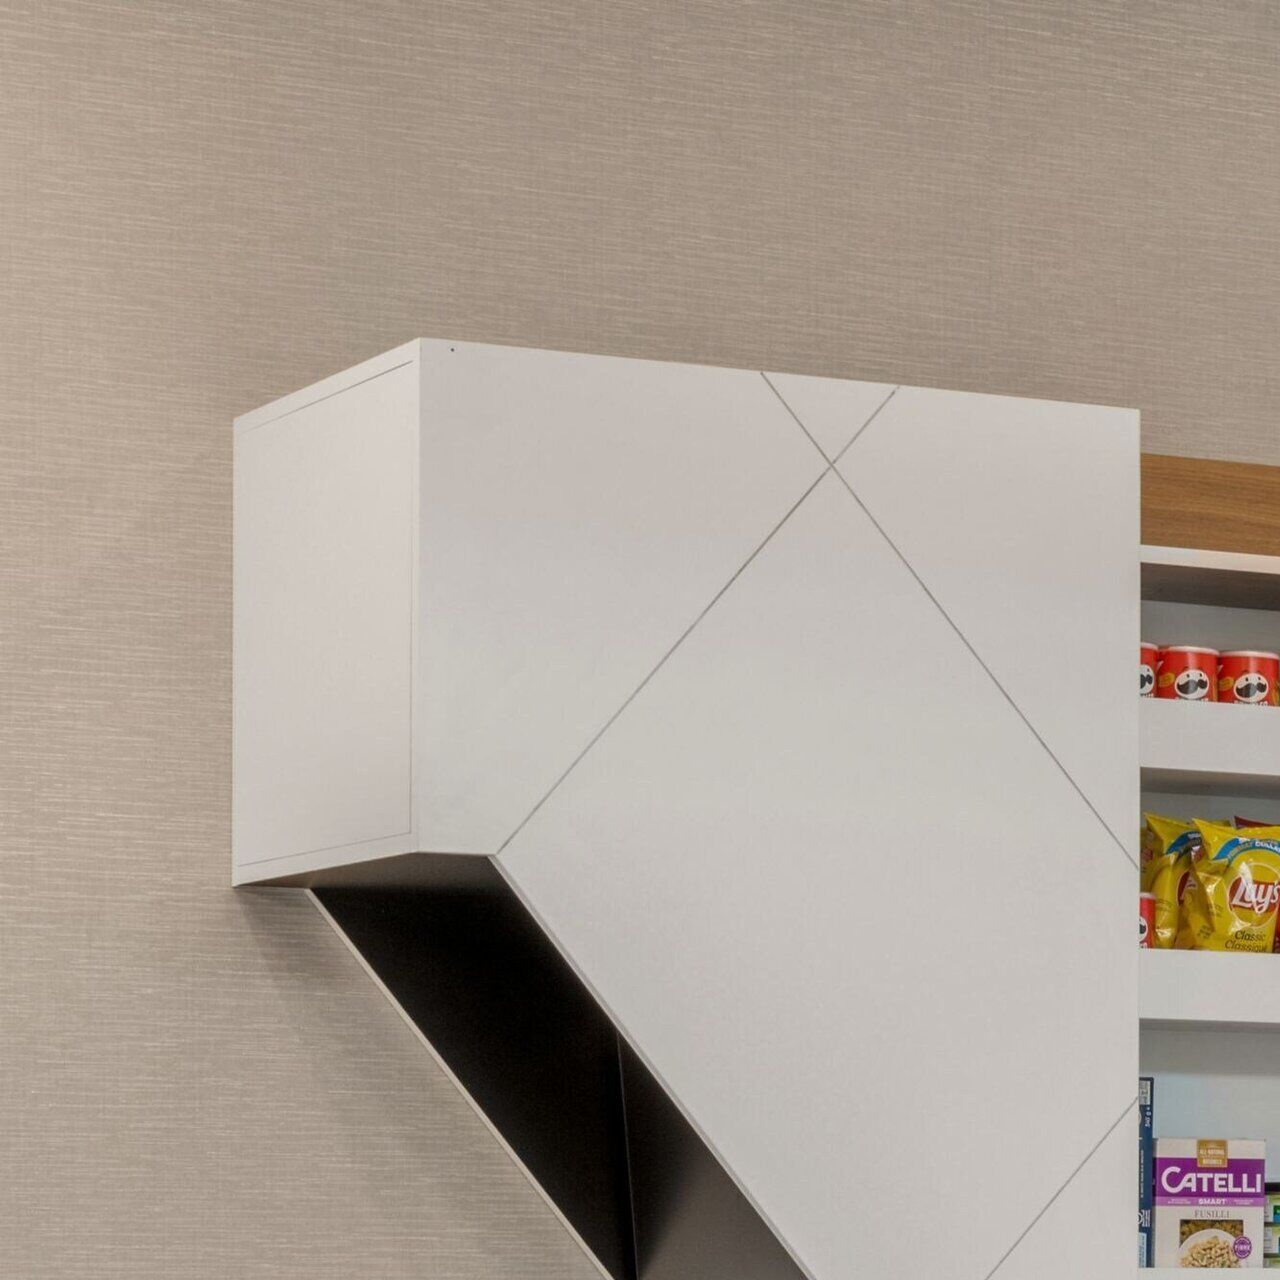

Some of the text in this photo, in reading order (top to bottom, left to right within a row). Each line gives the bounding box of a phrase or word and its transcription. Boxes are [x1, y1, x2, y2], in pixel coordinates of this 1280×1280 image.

[1234, 929, 1266, 941] Classic
[1161, 1166, 1261, 1194] CATELLI
[1194, 1209, 1230, 1219] FUSILLI
